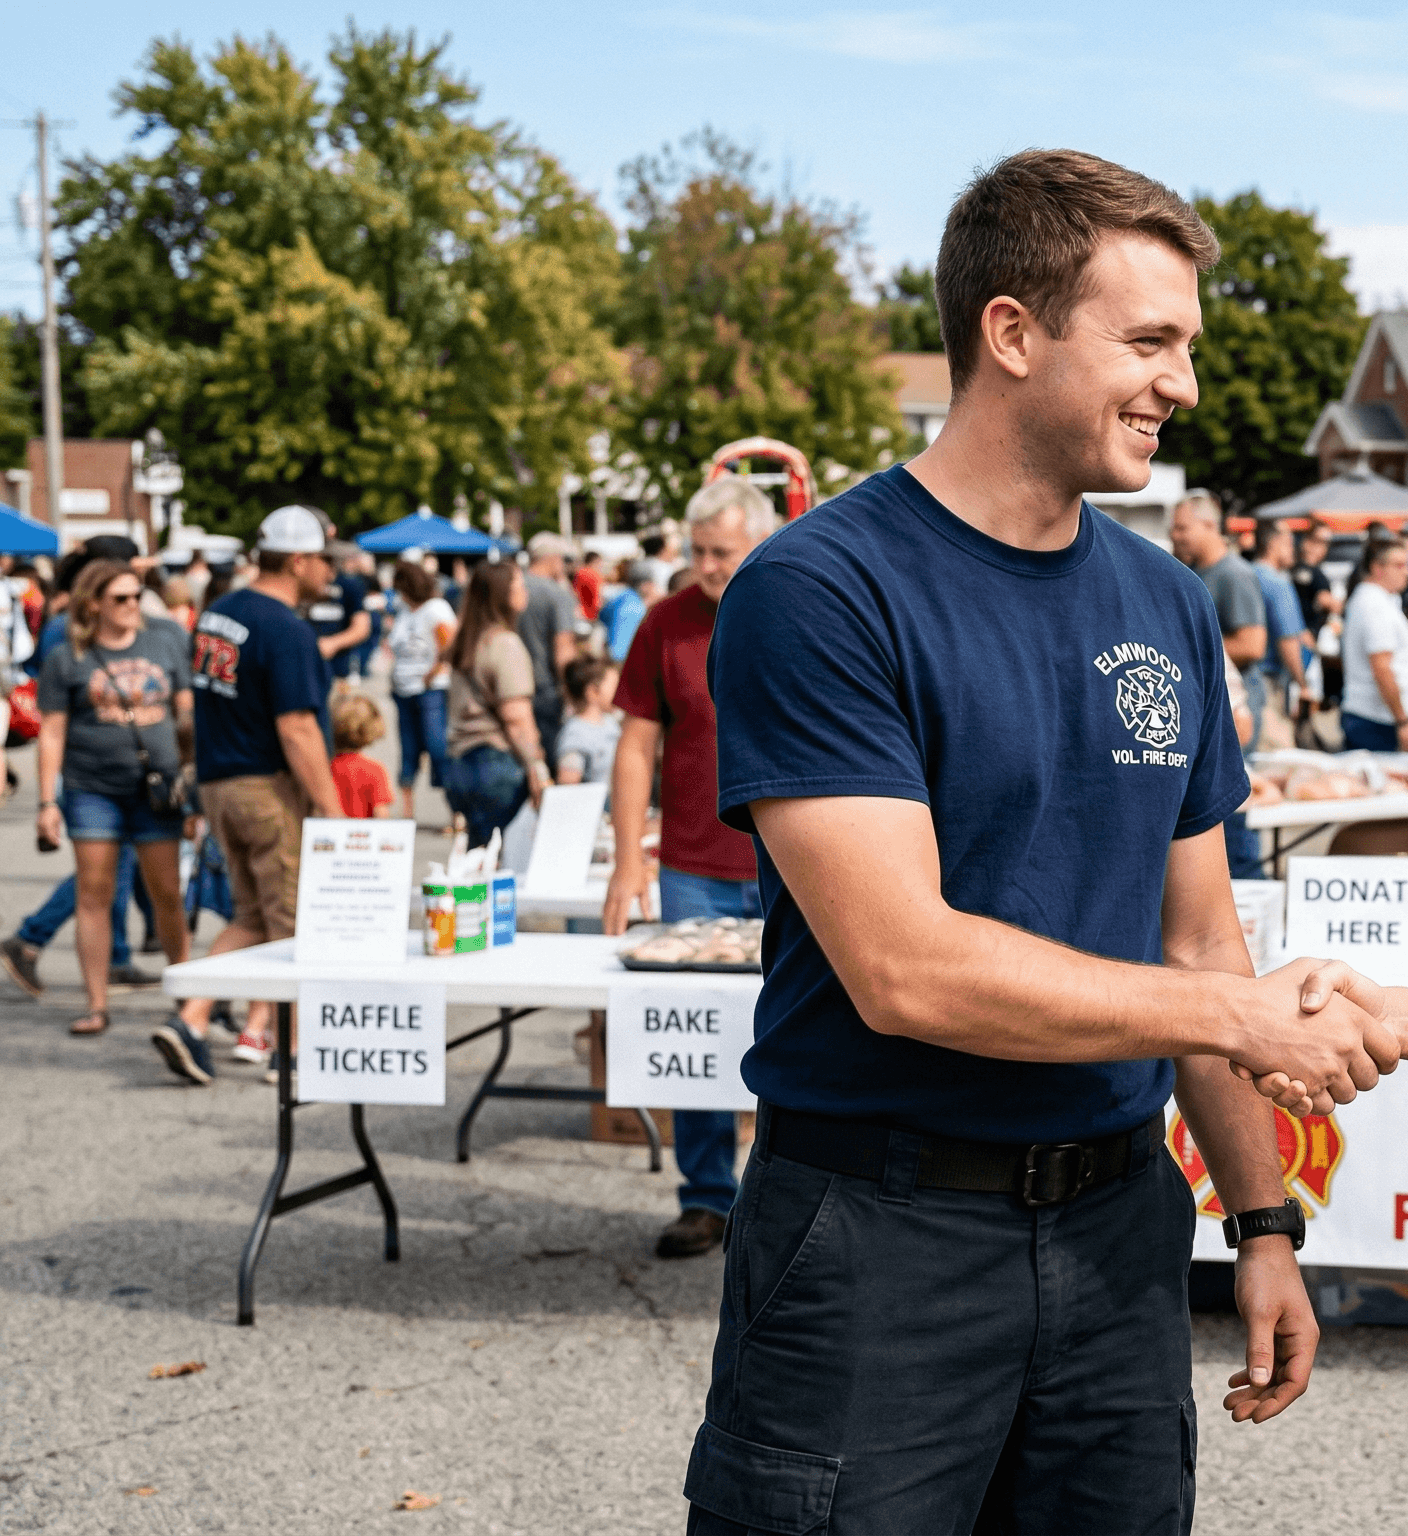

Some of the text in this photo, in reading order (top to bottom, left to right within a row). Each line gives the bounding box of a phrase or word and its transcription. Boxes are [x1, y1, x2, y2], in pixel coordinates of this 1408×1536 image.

[1093, 642, 1182, 682] ELMWOOD
[1142, 749, 1167, 766] FIRE
[1327, 920, 1400, 944] HERE
[321, 1004, 422, 1029] RAFFLE
[645, 1008, 719, 1033] BAKE
[315, 1047, 428, 1074] TICKETS
[648, 1052, 717, 1078] SALE
